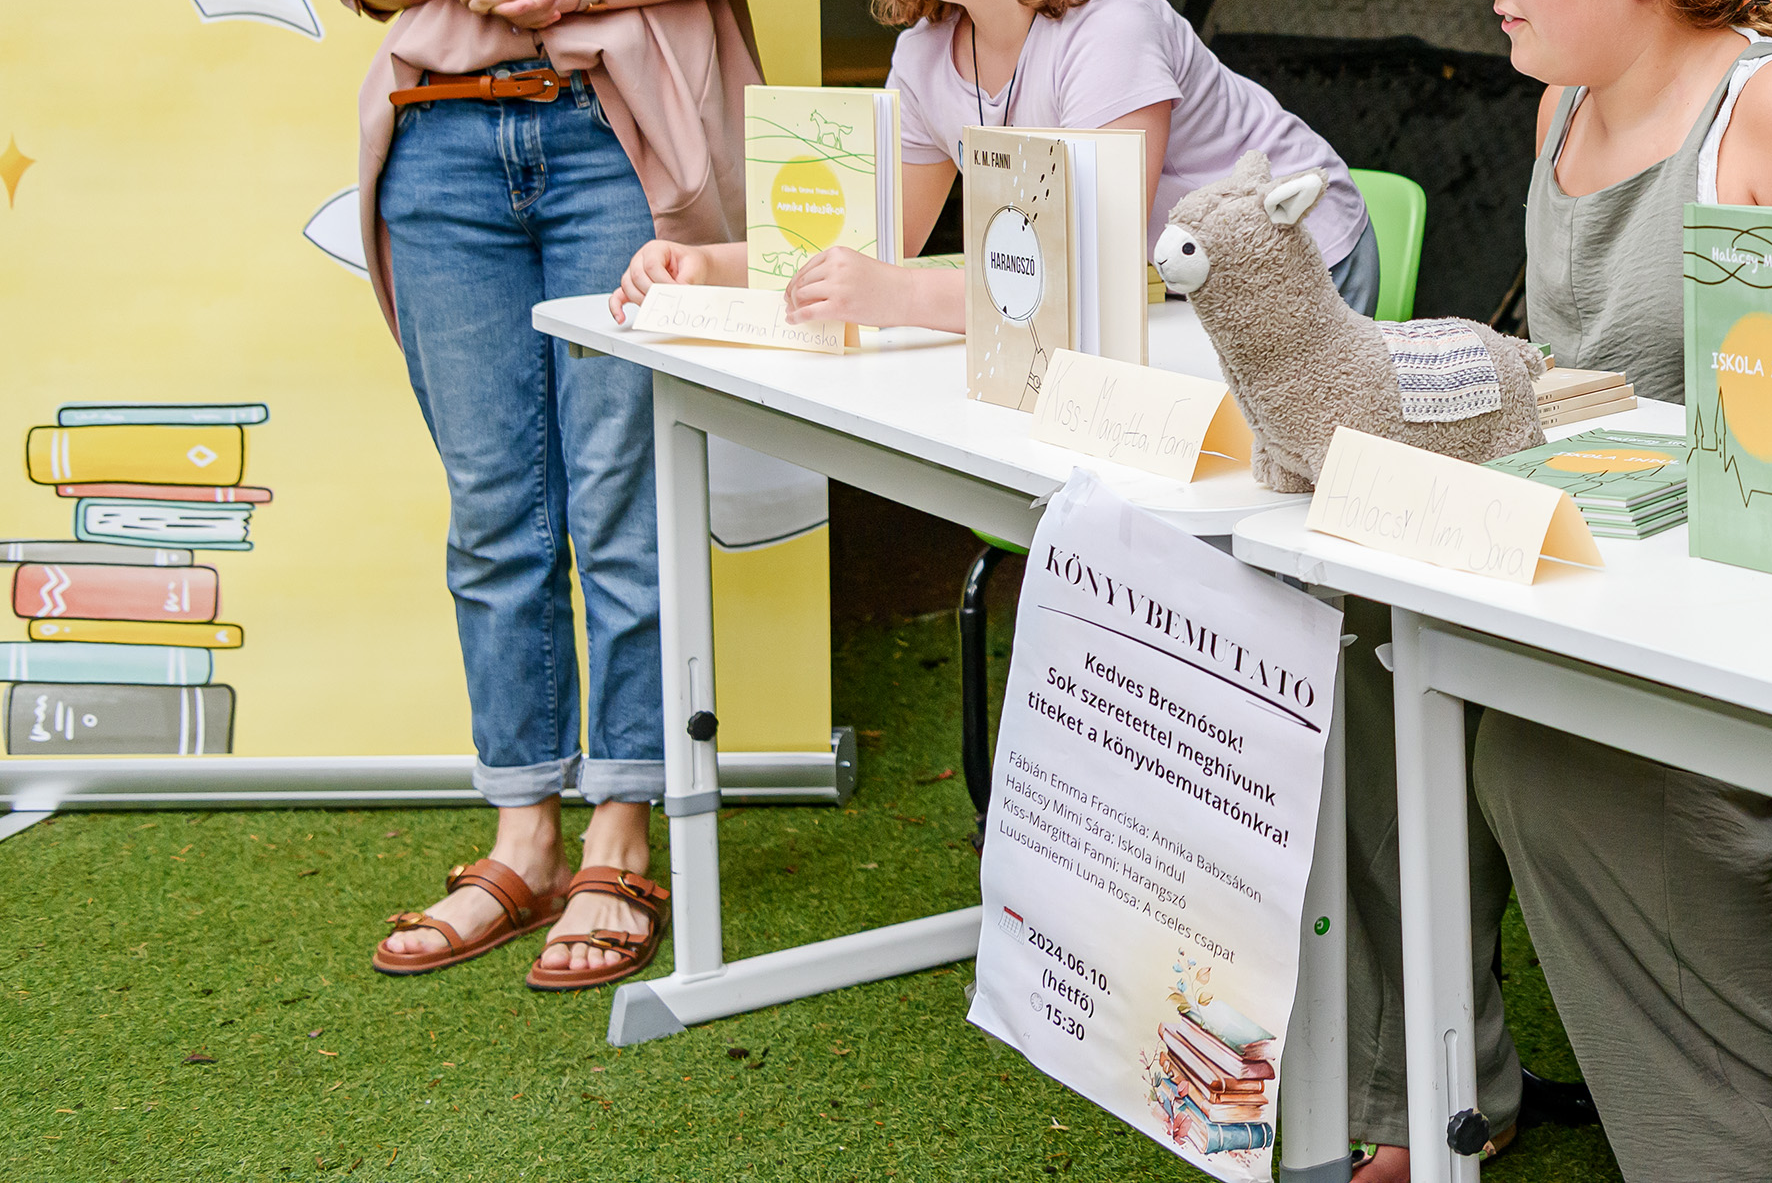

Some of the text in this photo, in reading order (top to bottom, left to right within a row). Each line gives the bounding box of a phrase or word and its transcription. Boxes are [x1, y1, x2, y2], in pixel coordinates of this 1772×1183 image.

[973, 149, 1011, 170] K. M. FANNI
[990, 251, 1035, 277] HARANGSZÓ
[1711, 246, 1759, 274] Halácsy
[723, 300, 767, 337] Emma
[1711, 351, 1765, 377] ISKOLA
[1155, 397, 1199, 459] Fanni
[1415, 475, 1464, 552] Mimi
[1468, 498, 1526, 578] Sára
[1045, 543, 1315, 709] KÖNYVBEMUTATÓ
[1046, 666, 1277, 807] Sok szeretettel meghívunk
[1085, 651, 1244, 755] Kedves Breznósok!
[1028, 690, 1290, 849] titeket a könyvbemutatónkra!
[1002, 796, 1187, 911] Kiss-Margittai Fanni: Harangszó
[1005, 773, 1187, 885] Halácsy Mimi Sára: Iskola indul
[1009, 750, 1262, 904] Fábián Emma Franciska: Annika Babzsákon
[999, 819, 1236, 965] Luusuaniemi Luna Rosa: A cseles csapat
[1028, 927, 1112, 996] 2024.06.10.
[1041, 968, 1095, 1019] (hétfő)
[1044, 1002, 1085, 1042] 15:30
